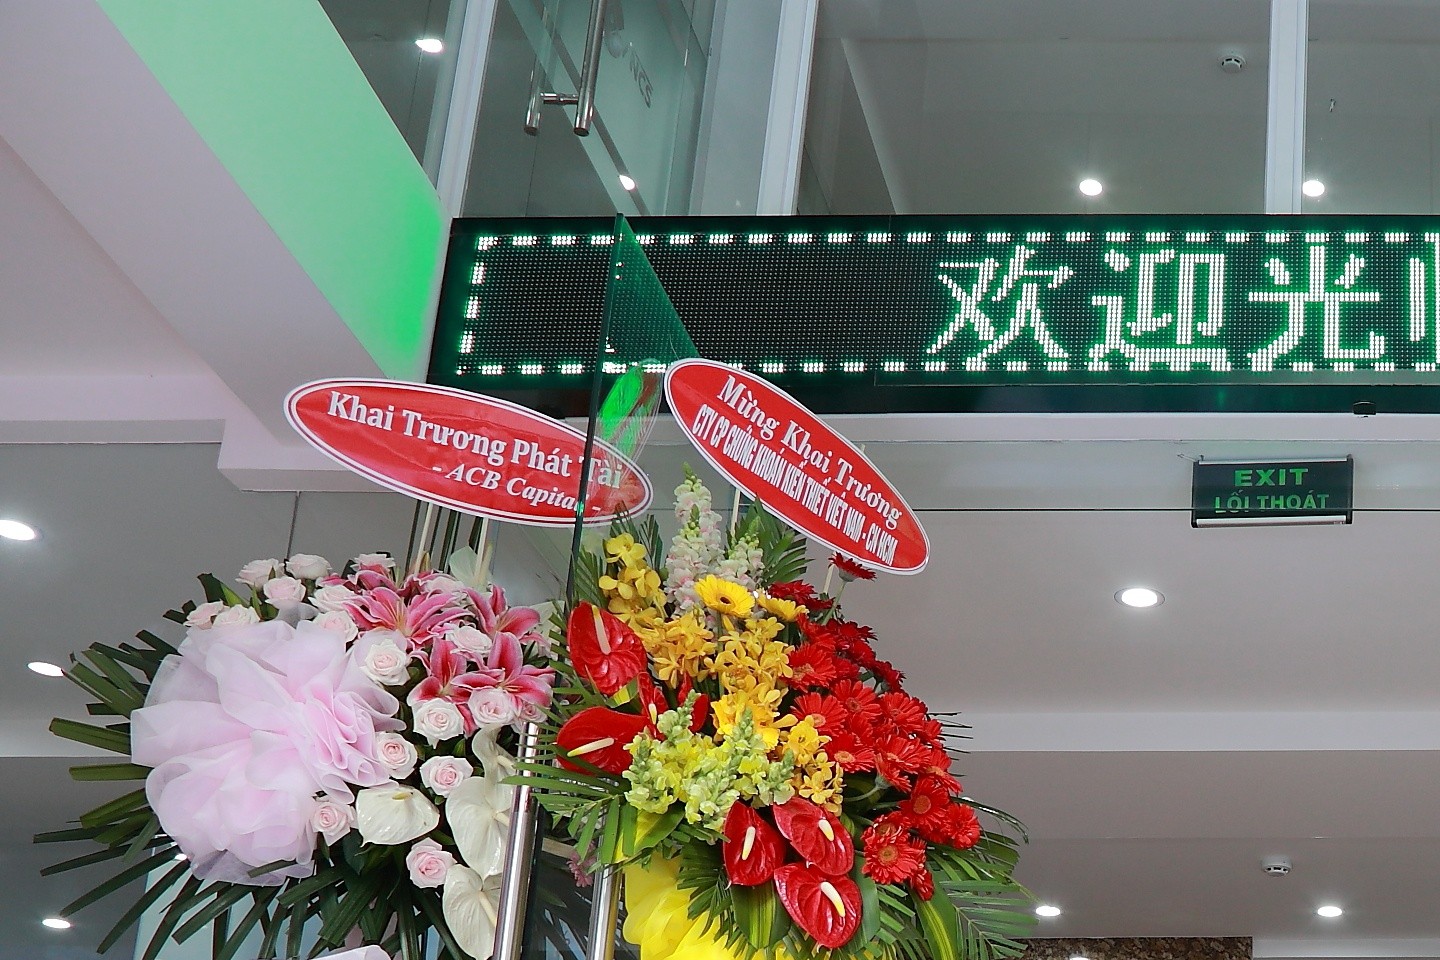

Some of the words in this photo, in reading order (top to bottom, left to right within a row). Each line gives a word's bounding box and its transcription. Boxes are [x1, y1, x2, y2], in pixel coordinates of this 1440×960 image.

[327, 391, 395, 431] Khai
[402, 409, 508, 466] Trương
[510, 438, 573, 478] Phát
[716, 374, 780, 440] Mừng
[781, 419, 834, 474] Khai
[834, 458, 903, 530] Trương
[445, 463, 502, 490] ACB
[692, 403, 717, 442] CTY
[710, 417, 731, 449] CP
[751, 443, 787, 488] KHOÁN
[780, 459, 809, 502] KIẾN
[802, 476, 832, 517] THIẾT
[825, 491, 849, 530] VIỆT
[843, 508, 867, 544] NAM
[865, 520, 881, 555] CN
[876, 529, 899, 566] HCM
[1214, 489, 1249, 514] LỐI
[1257, 489, 1329, 513] THOÁT
[1234, 468, 1309, 487] EXIT
